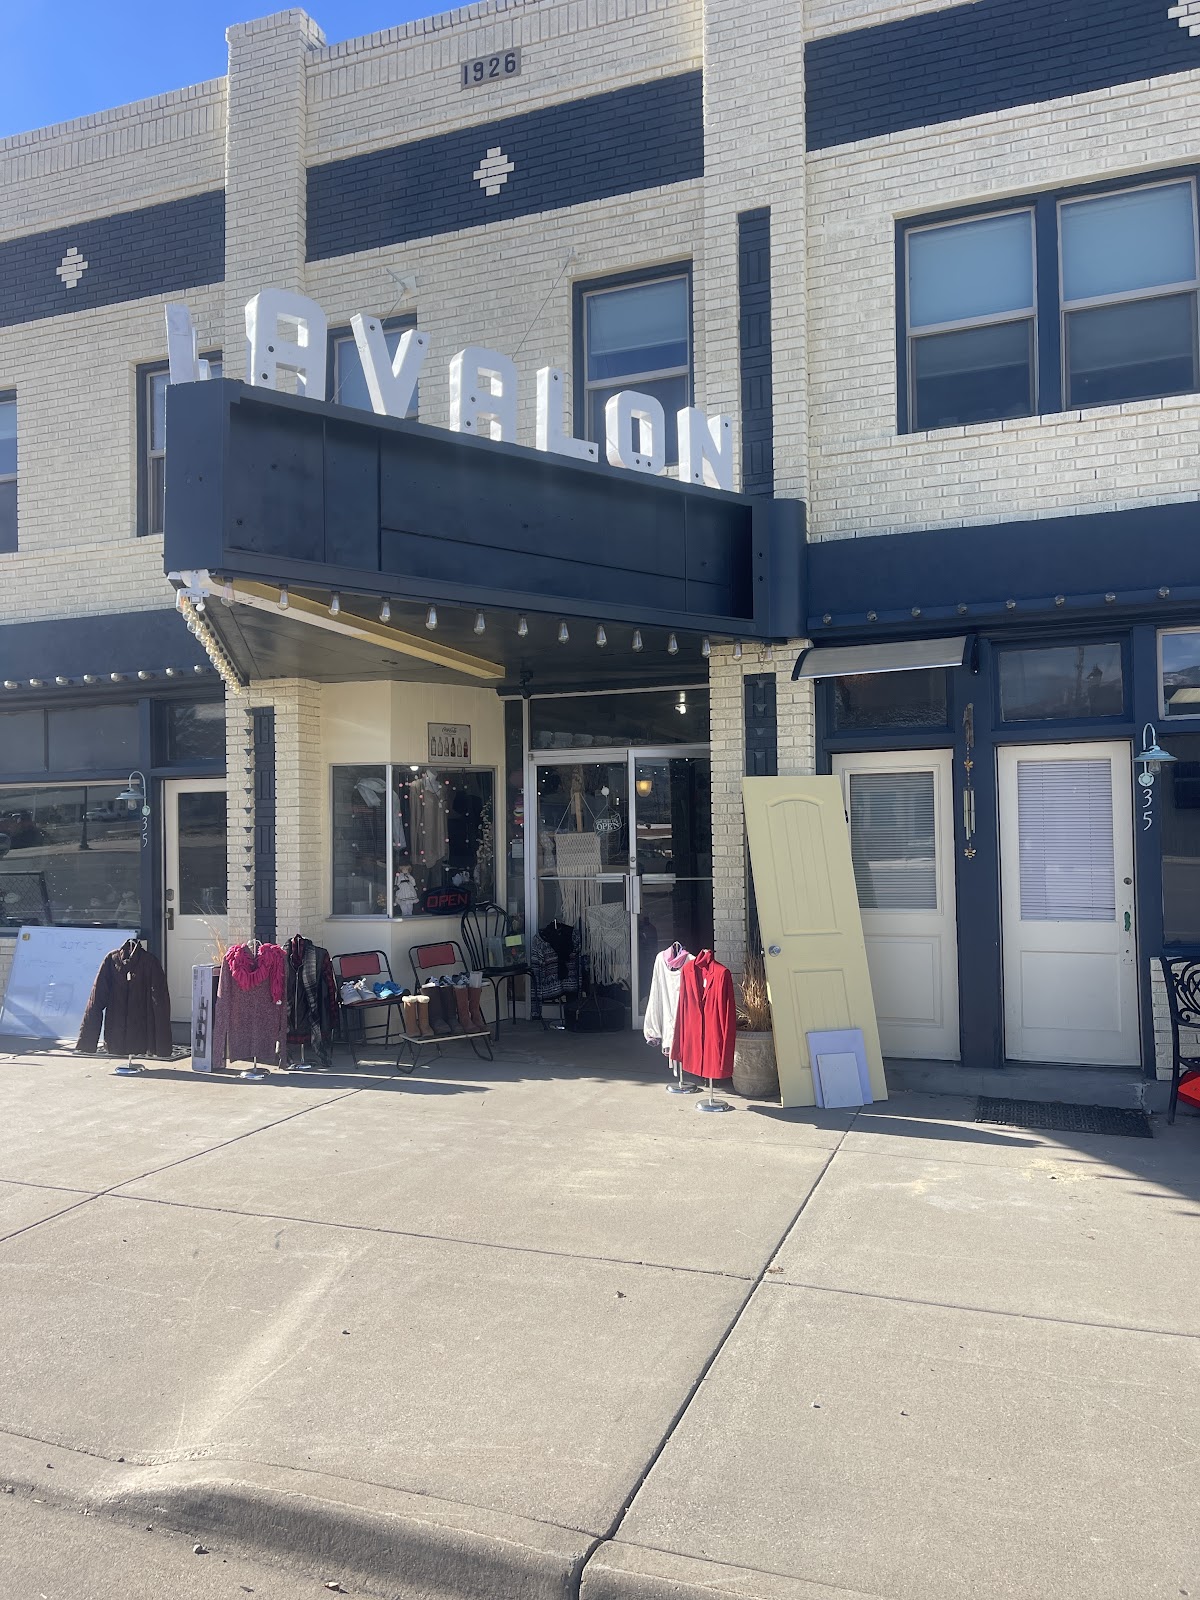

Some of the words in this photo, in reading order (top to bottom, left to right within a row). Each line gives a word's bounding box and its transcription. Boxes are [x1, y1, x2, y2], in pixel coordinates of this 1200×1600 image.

[464, 52, 516, 84] 1926
[245, 288, 734, 492] AVALON
[1142, 788, 1153, 831] 35
[141, 816, 148, 848] 35
[596, 822, 620, 831] OPEN
[427, 893, 468, 908] OPEN
